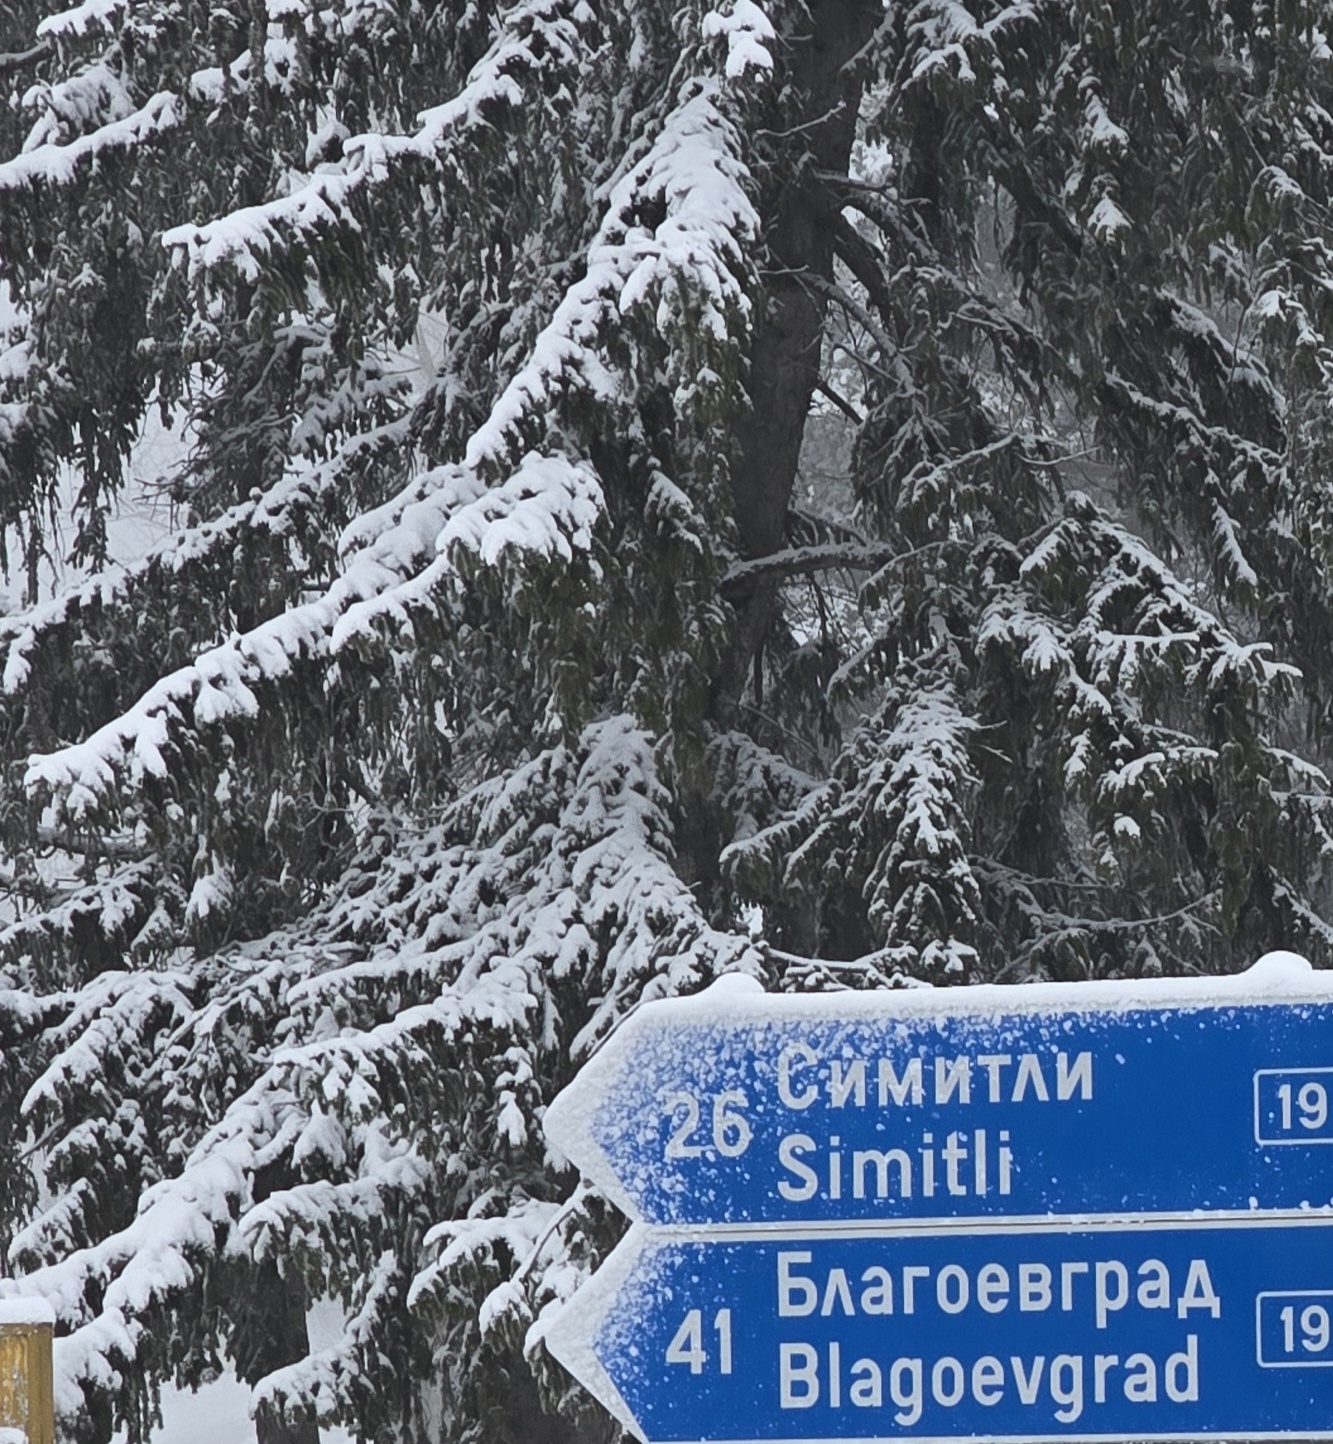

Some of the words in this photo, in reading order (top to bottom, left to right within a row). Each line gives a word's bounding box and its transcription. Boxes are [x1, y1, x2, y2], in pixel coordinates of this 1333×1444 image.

[776, 1048, 1094, 1109] Симитли
[1278, 1082, 1328, 1130] 19
[662, 1091, 752, 1159] 26
[777, 1129, 1014, 1202] Simitli
[777, 1250, 1221, 1329] Благоевград
[665, 1308, 732, 1375] 41
[1280, 1304, 1330, 1353] 19
[779, 1334, 1199, 1426] Blagoevgrad
